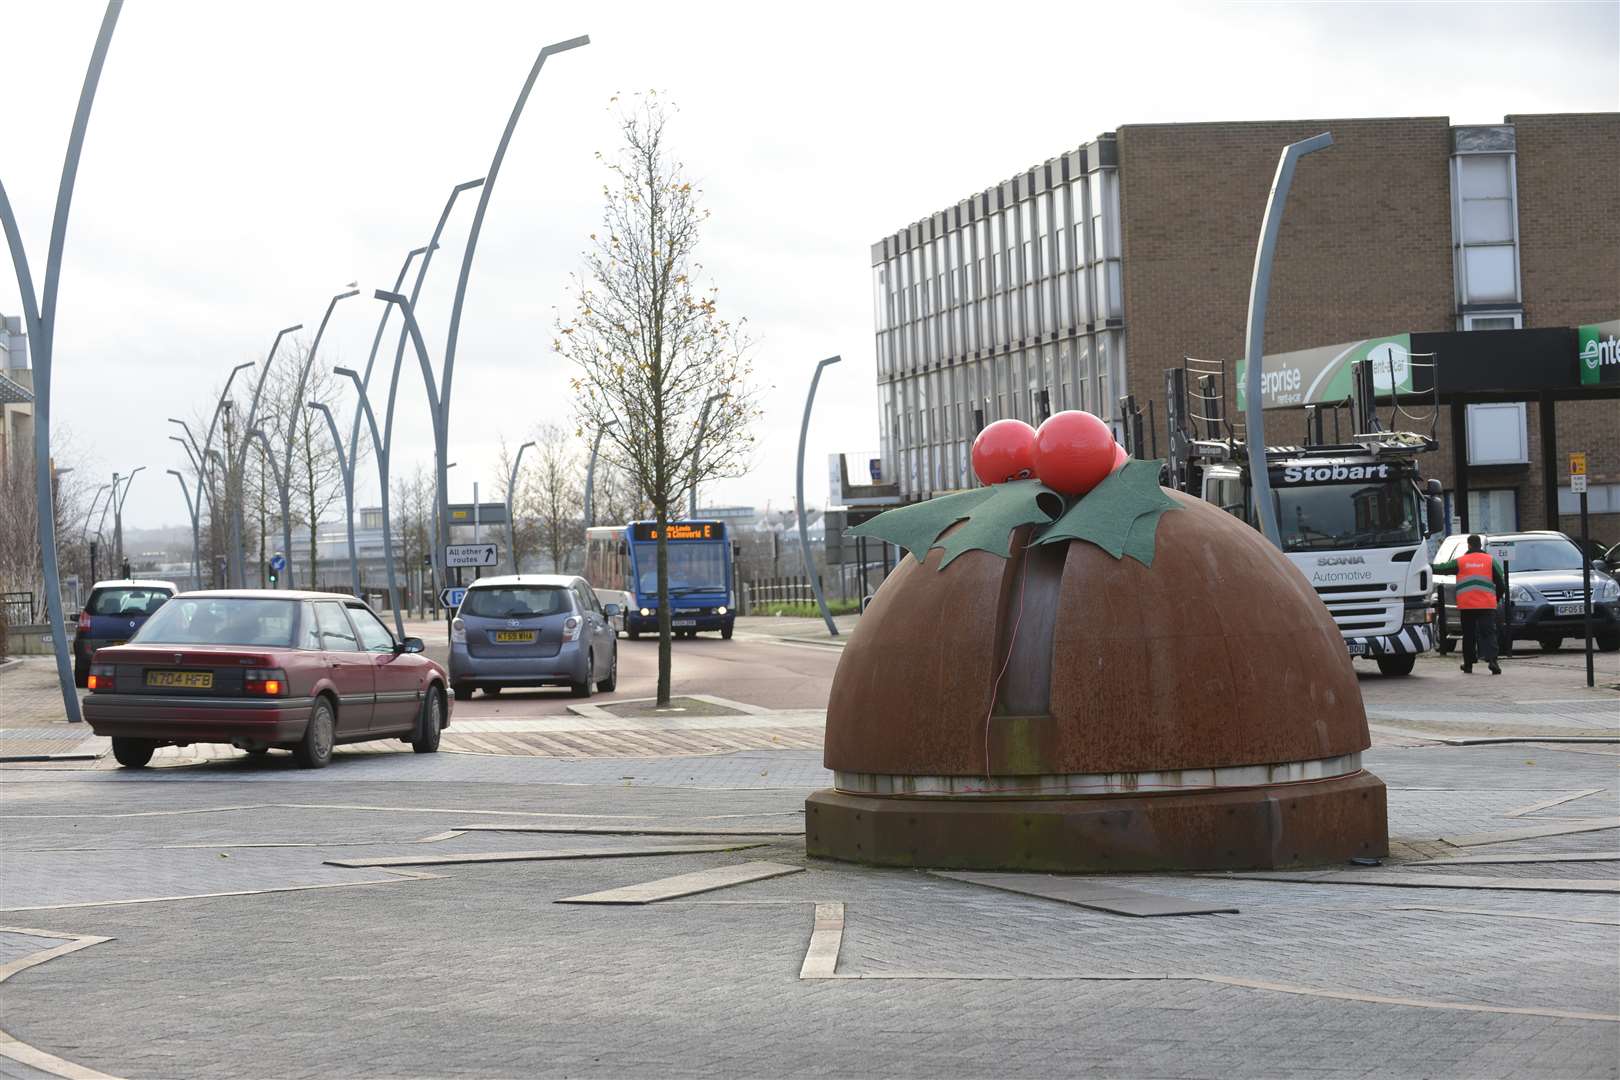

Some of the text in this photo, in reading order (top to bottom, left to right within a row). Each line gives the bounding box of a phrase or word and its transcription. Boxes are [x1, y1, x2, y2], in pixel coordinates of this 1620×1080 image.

[1284, 463, 1389, 483] Stobart
[704, 525, 711, 538] E
[1317, 556, 1365, 566] SCANIA
[1312, 570, 1372, 582] Automotive
